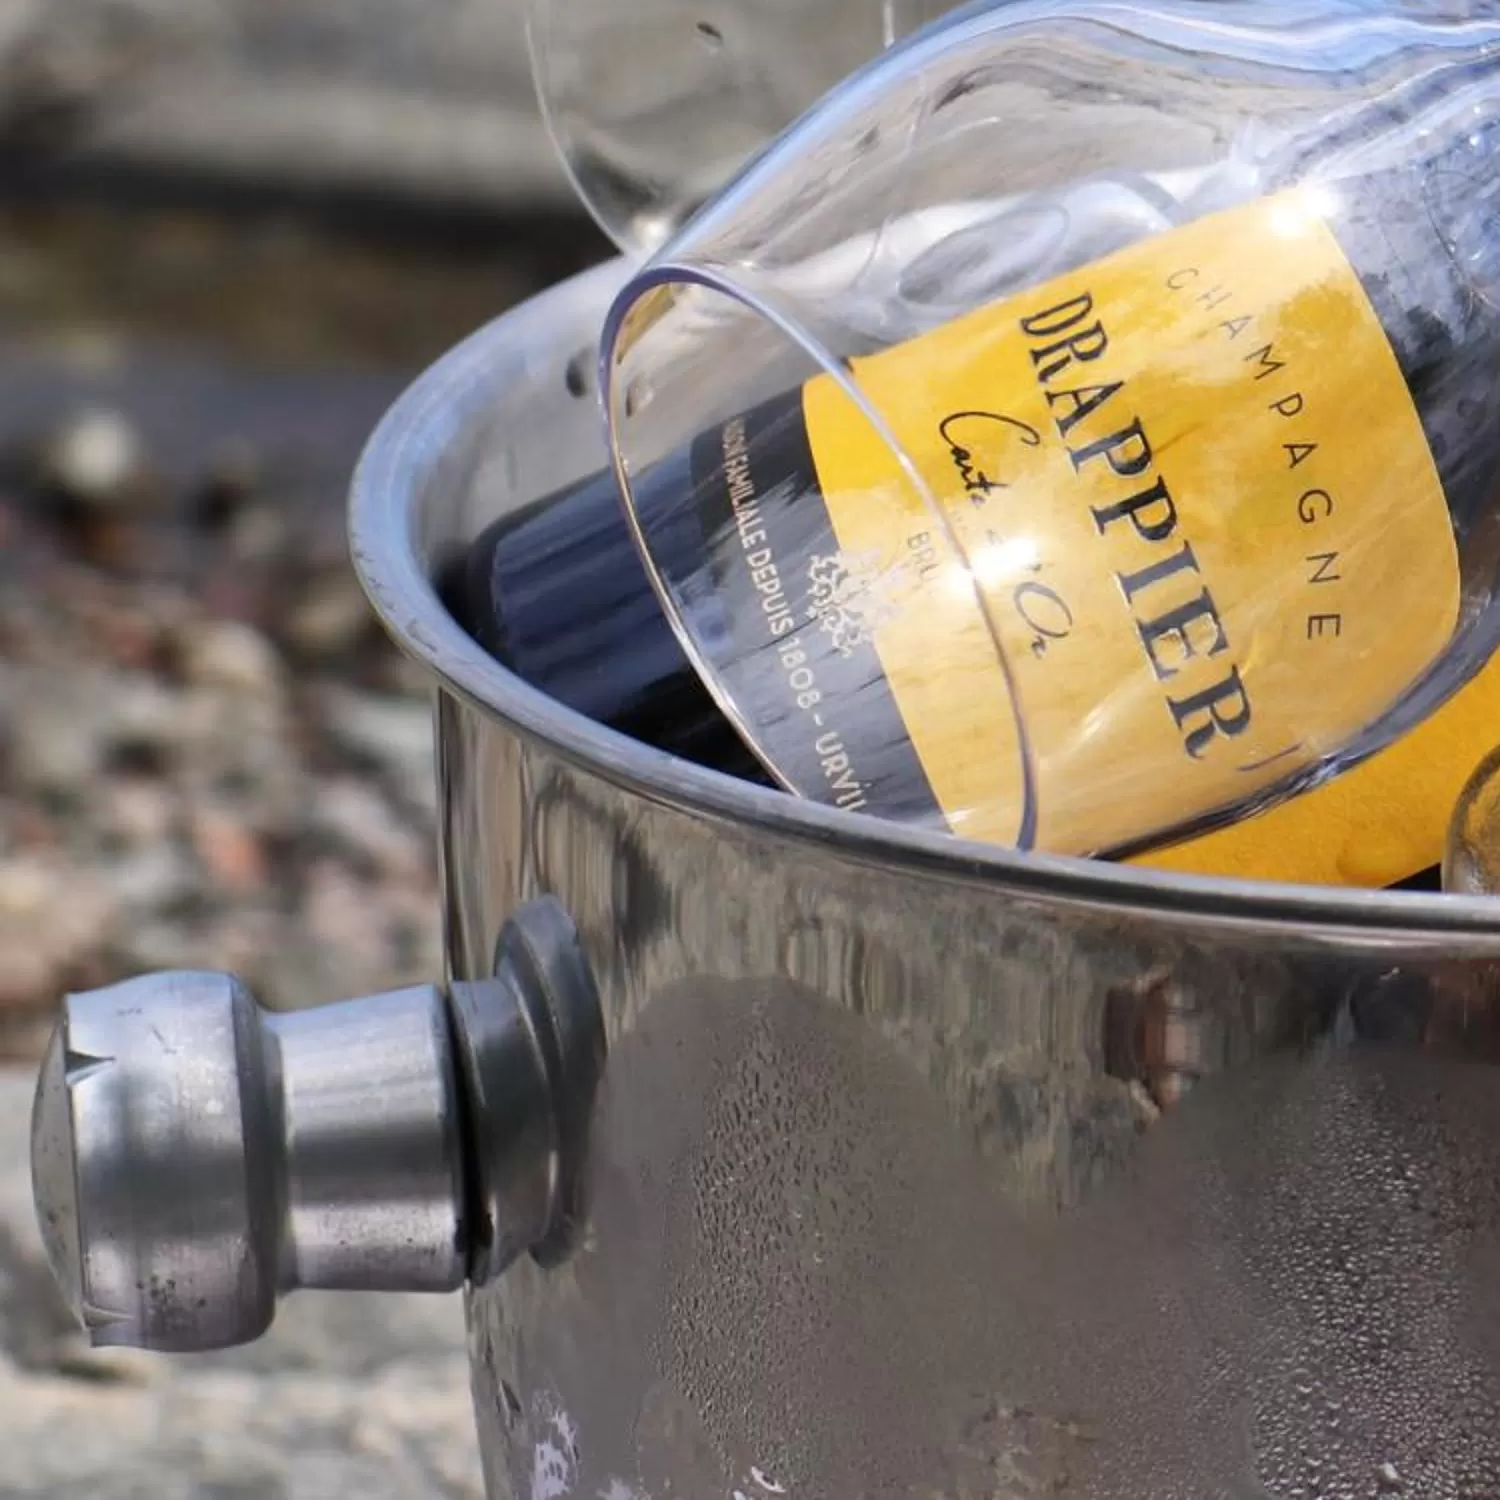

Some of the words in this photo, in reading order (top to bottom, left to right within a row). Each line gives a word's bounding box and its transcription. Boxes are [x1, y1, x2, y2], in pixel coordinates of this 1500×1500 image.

[746, 547, 795, 635] DEPUIS
[777, 636, 822, 709] 1808
[1019, 290, 1253, 761] DRAPPIER
[1166, 266, 1341, 640] CHAMPAGNE
